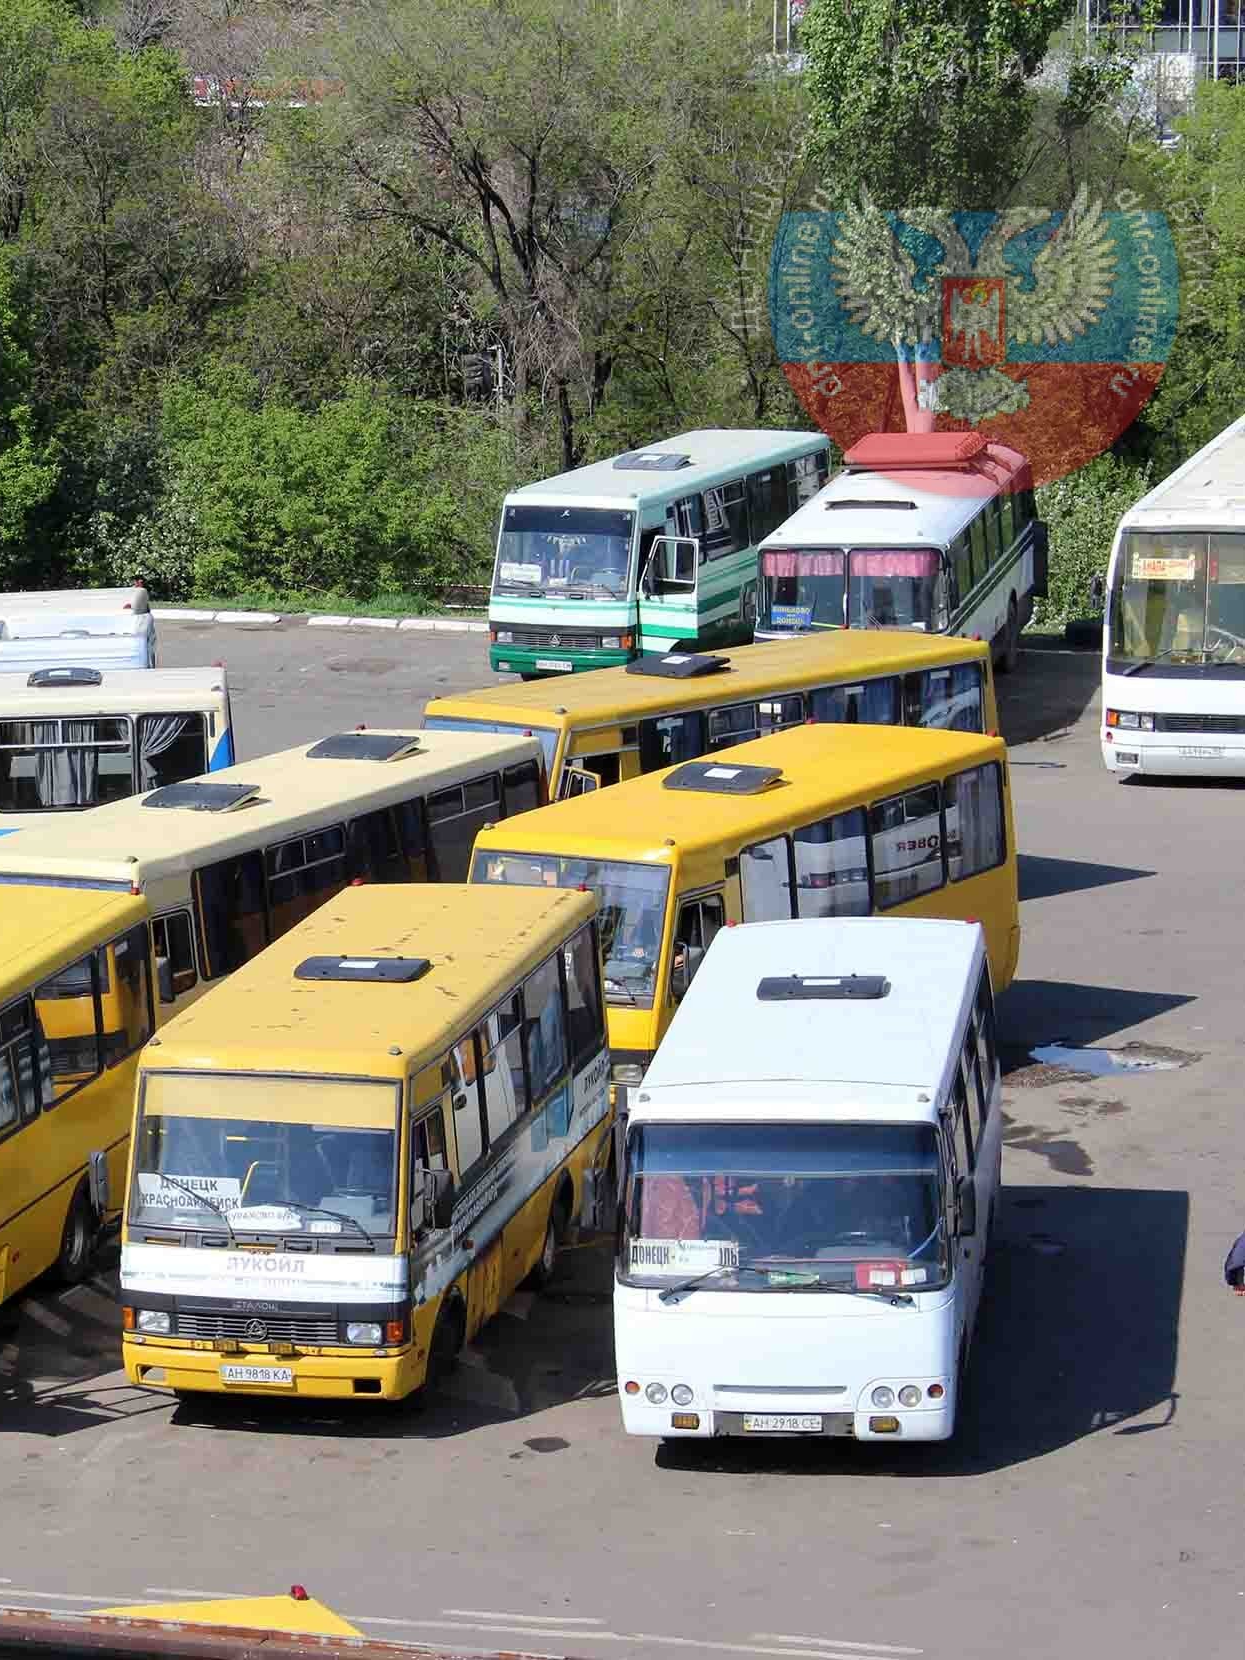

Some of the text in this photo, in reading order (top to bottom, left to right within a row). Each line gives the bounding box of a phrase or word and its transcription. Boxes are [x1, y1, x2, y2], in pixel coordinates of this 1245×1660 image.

[160, 1177, 218, 1192] ДОНЕЦК
[227, 1255, 305, 1273] ЛУКОЙЛ
[631, 1245, 669, 1268] ДОНЕЦК
[227, 1368, 288, 1380] AH 9818 KA
[753, 1417, 769, 1428] AH
[772, 1417, 798, 1429] 2918
